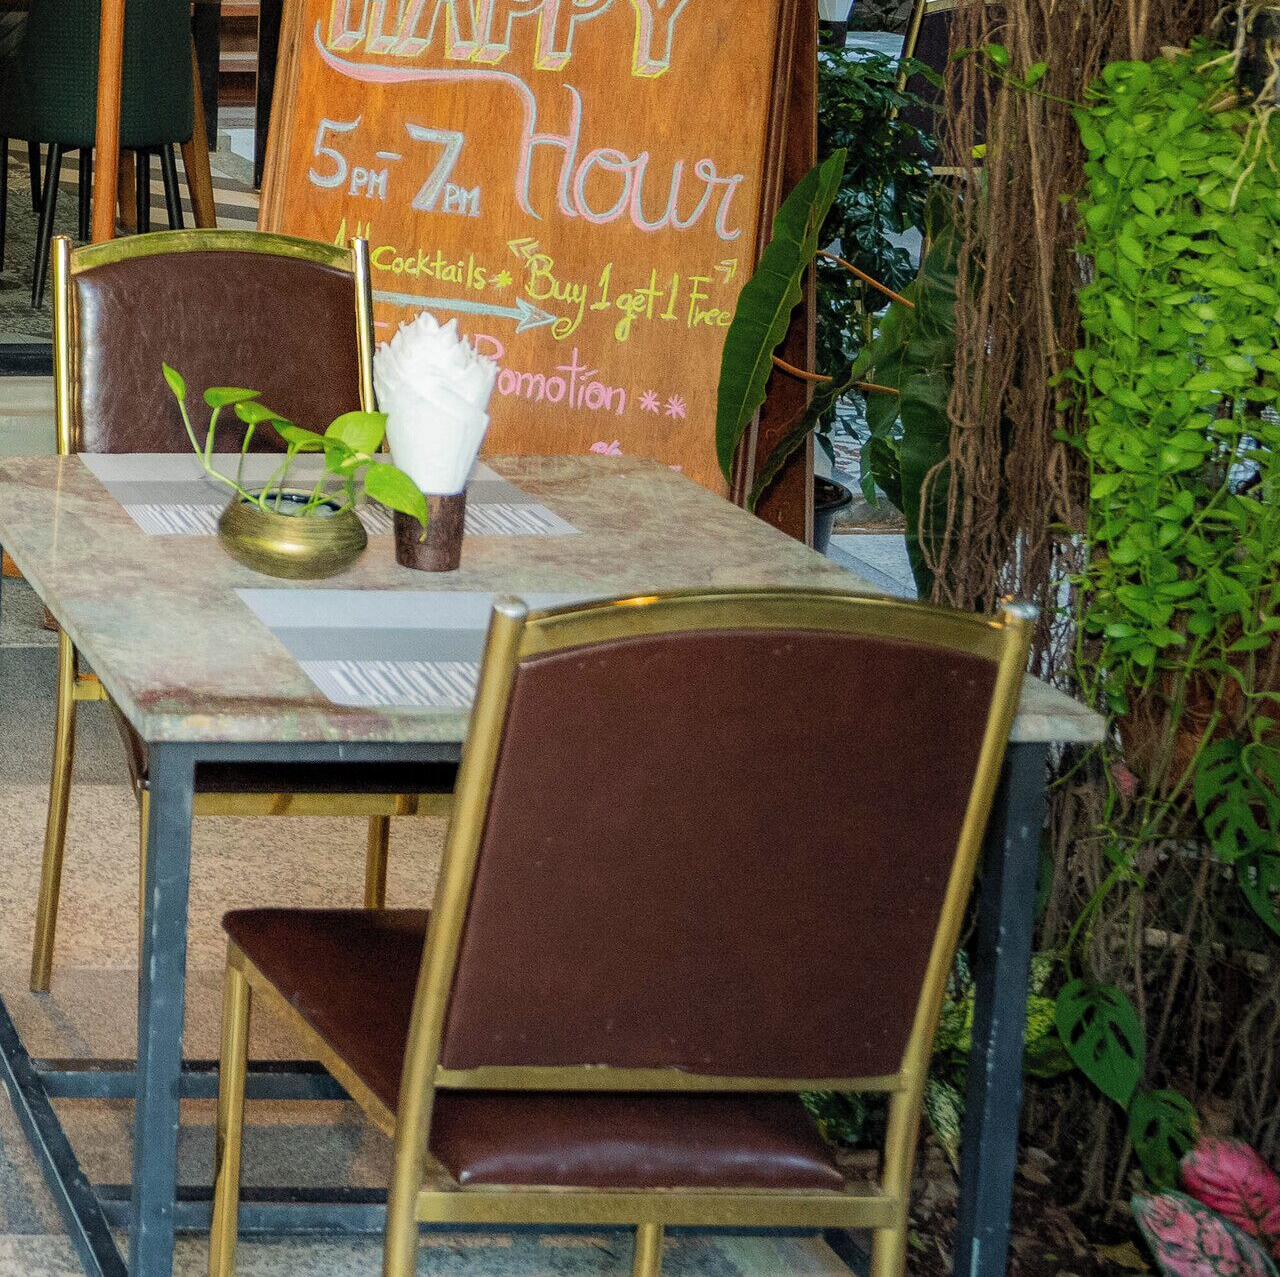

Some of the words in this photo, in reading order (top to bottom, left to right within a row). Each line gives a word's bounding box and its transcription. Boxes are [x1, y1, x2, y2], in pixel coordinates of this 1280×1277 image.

[512, 73, 744, 241] Hour
[590, 262, 613, 311] 1
[615, 268, 664, 342] get
[660, 272, 679, 320] 1
